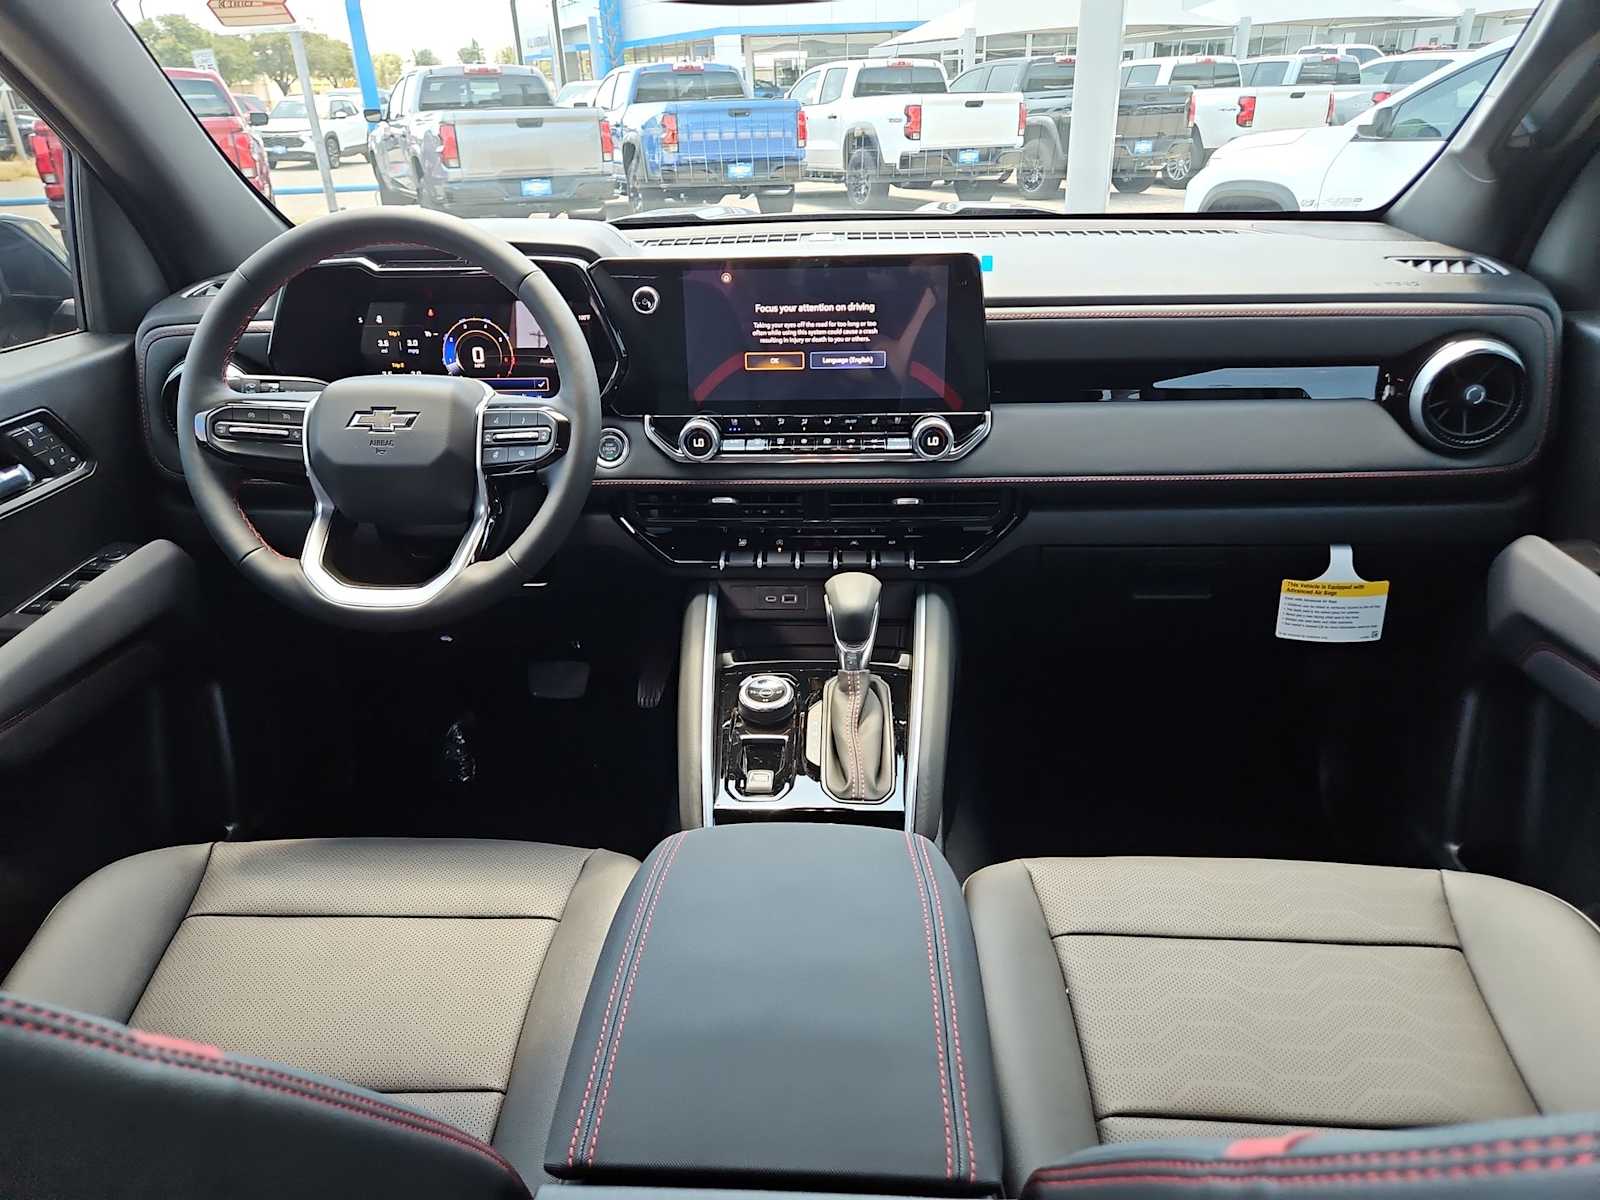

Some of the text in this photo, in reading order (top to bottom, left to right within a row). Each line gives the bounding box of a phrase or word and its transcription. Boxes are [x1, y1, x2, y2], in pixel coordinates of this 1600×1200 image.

[754, 302, 875, 315] Focus your attention on driving
[753, 321, 771, 330] Taking
[771, 322, 783, 330] your
[784, 322, 797, 330] eyes
[808, 329, 827, 337] system
[863, 327, 878, 335] crash
[822, 356, 874, 365] Language (English)
